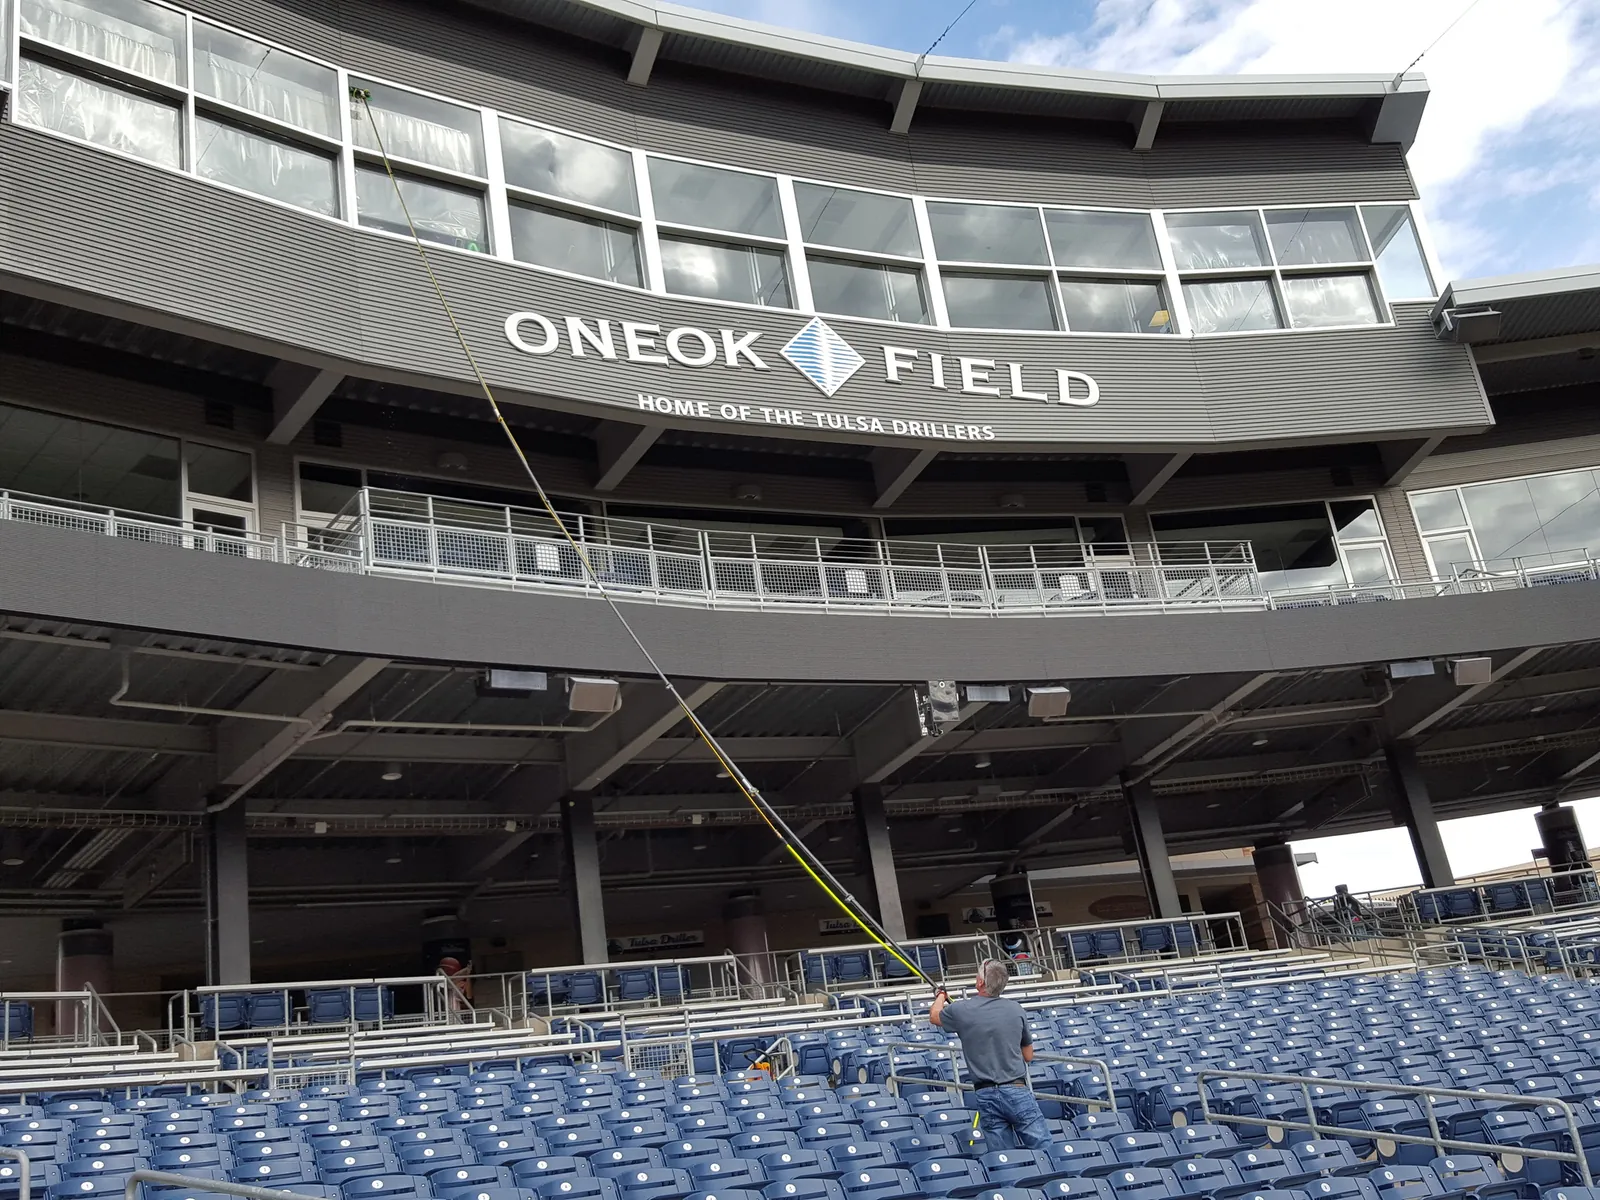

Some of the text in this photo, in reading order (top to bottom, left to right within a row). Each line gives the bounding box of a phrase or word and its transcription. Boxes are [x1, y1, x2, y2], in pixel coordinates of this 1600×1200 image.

[504, 311, 1100, 407] ONEOK FIELD
[637, 393, 996, 442] HOME OF THE TULSA DRILLERS
